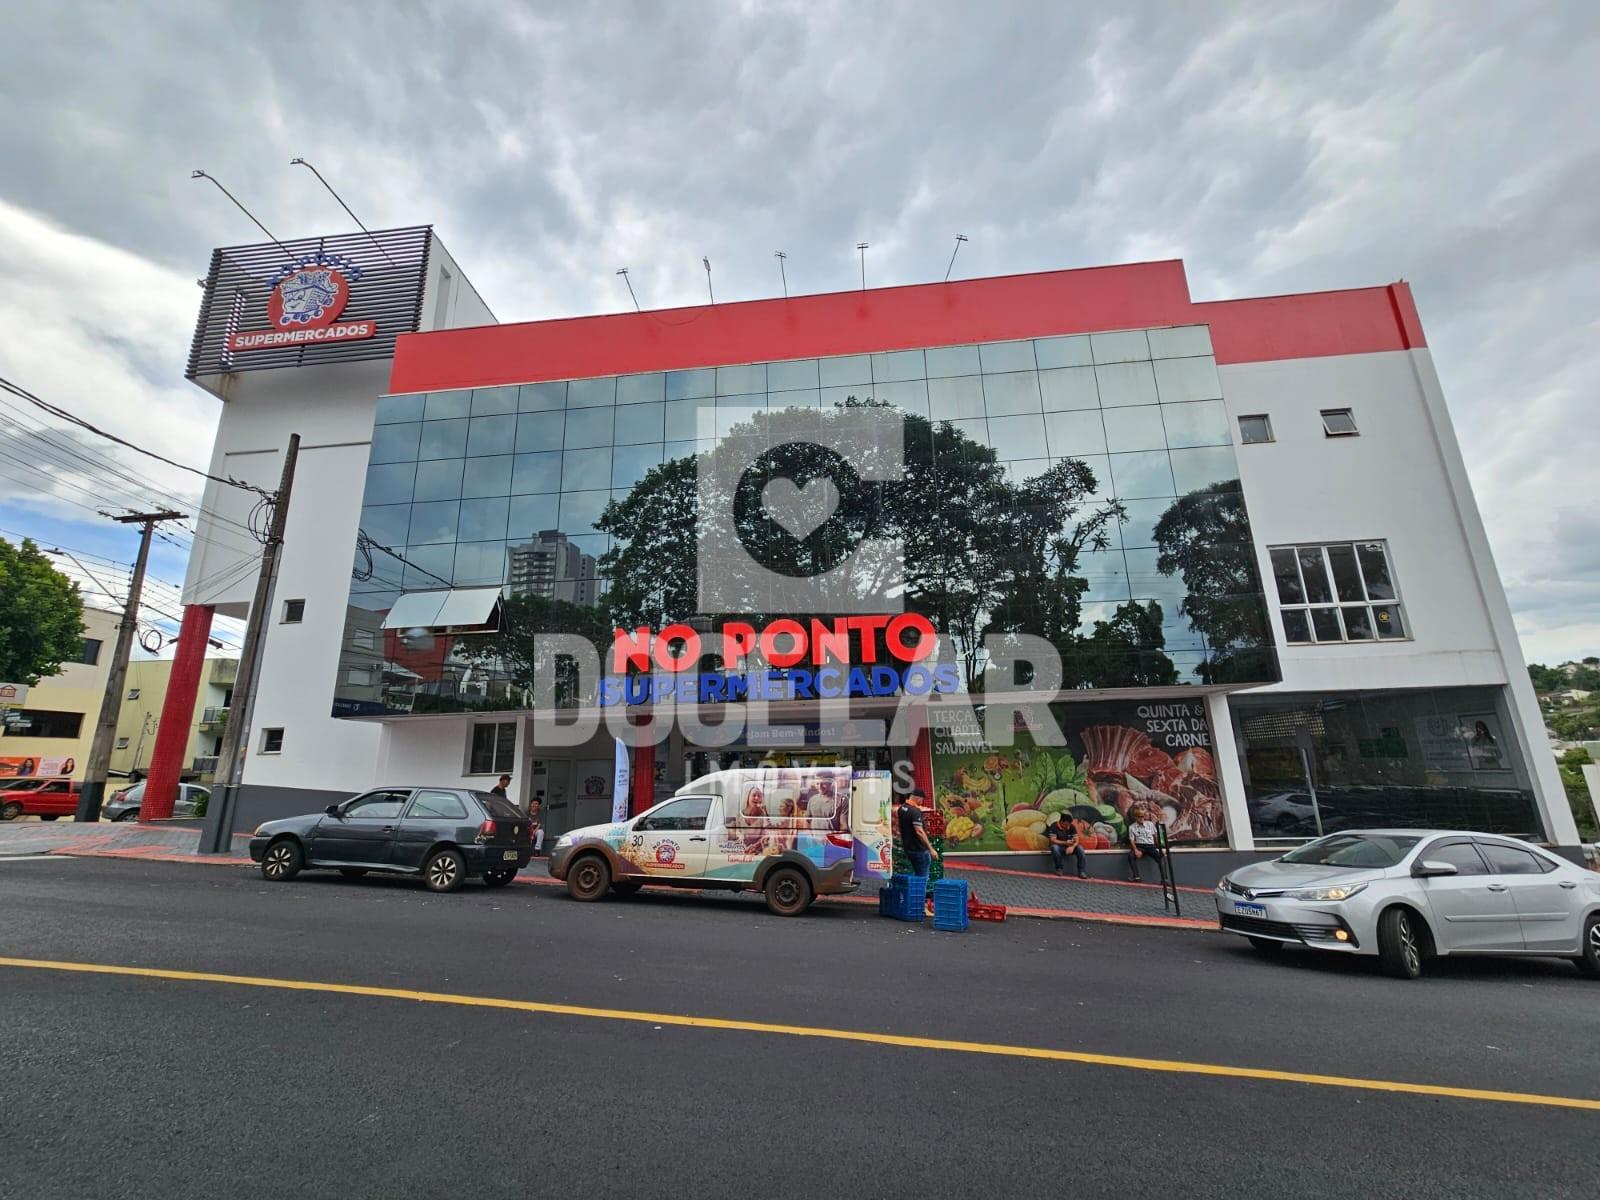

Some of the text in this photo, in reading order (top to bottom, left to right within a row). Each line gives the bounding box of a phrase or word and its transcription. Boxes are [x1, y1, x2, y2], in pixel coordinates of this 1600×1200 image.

[235, 324, 369, 347] SUPERMERCADOS
[613, 612, 937, 673] NO PONTO
[598, 664, 960, 706] SUPERMERCADOS
[933, 710, 972, 725] TERÇA
[1137, 704, 1205, 718] QUINTA &
[934, 725, 985, 738] QUARTA
[1146, 718, 1208, 732] SEXTA DA
[772, 727, 835, 738] Bem-Vindos!
[1165, 733, 1212, 747] CARNE
[631, 835, 644, 847] 30
[652, 838, 681, 851] NO PONTO
